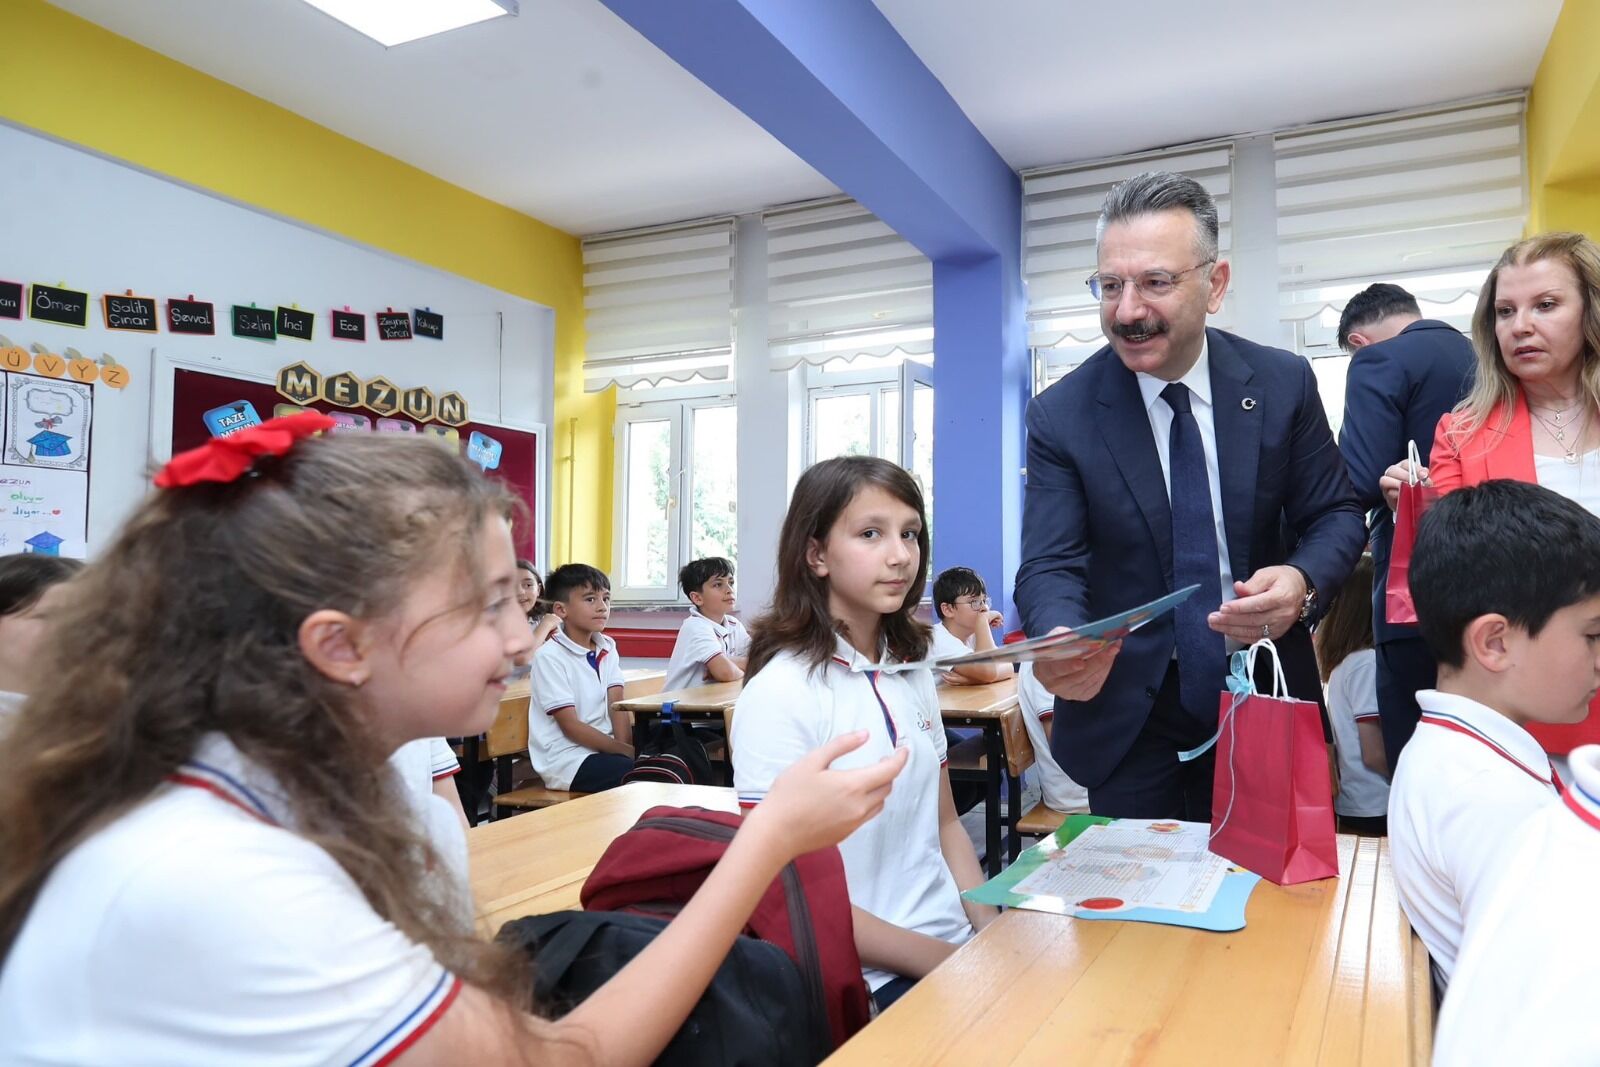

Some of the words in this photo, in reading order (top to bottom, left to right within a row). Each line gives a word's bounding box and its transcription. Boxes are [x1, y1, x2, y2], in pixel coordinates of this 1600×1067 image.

[36, 290, 80, 312] Ömer
[111, 300, 148, 314] Salih
[109, 313, 149, 327] Çınar
[171, 307, 211, 326] Şevval
[239, 314, 271, 331] Selin
[283, 312, 303, 331] İnci
[339, 319, 358, 332] Ece
[286, 370, 461, 422] MEZUN
[218, 412, 246, 427] TAZE
